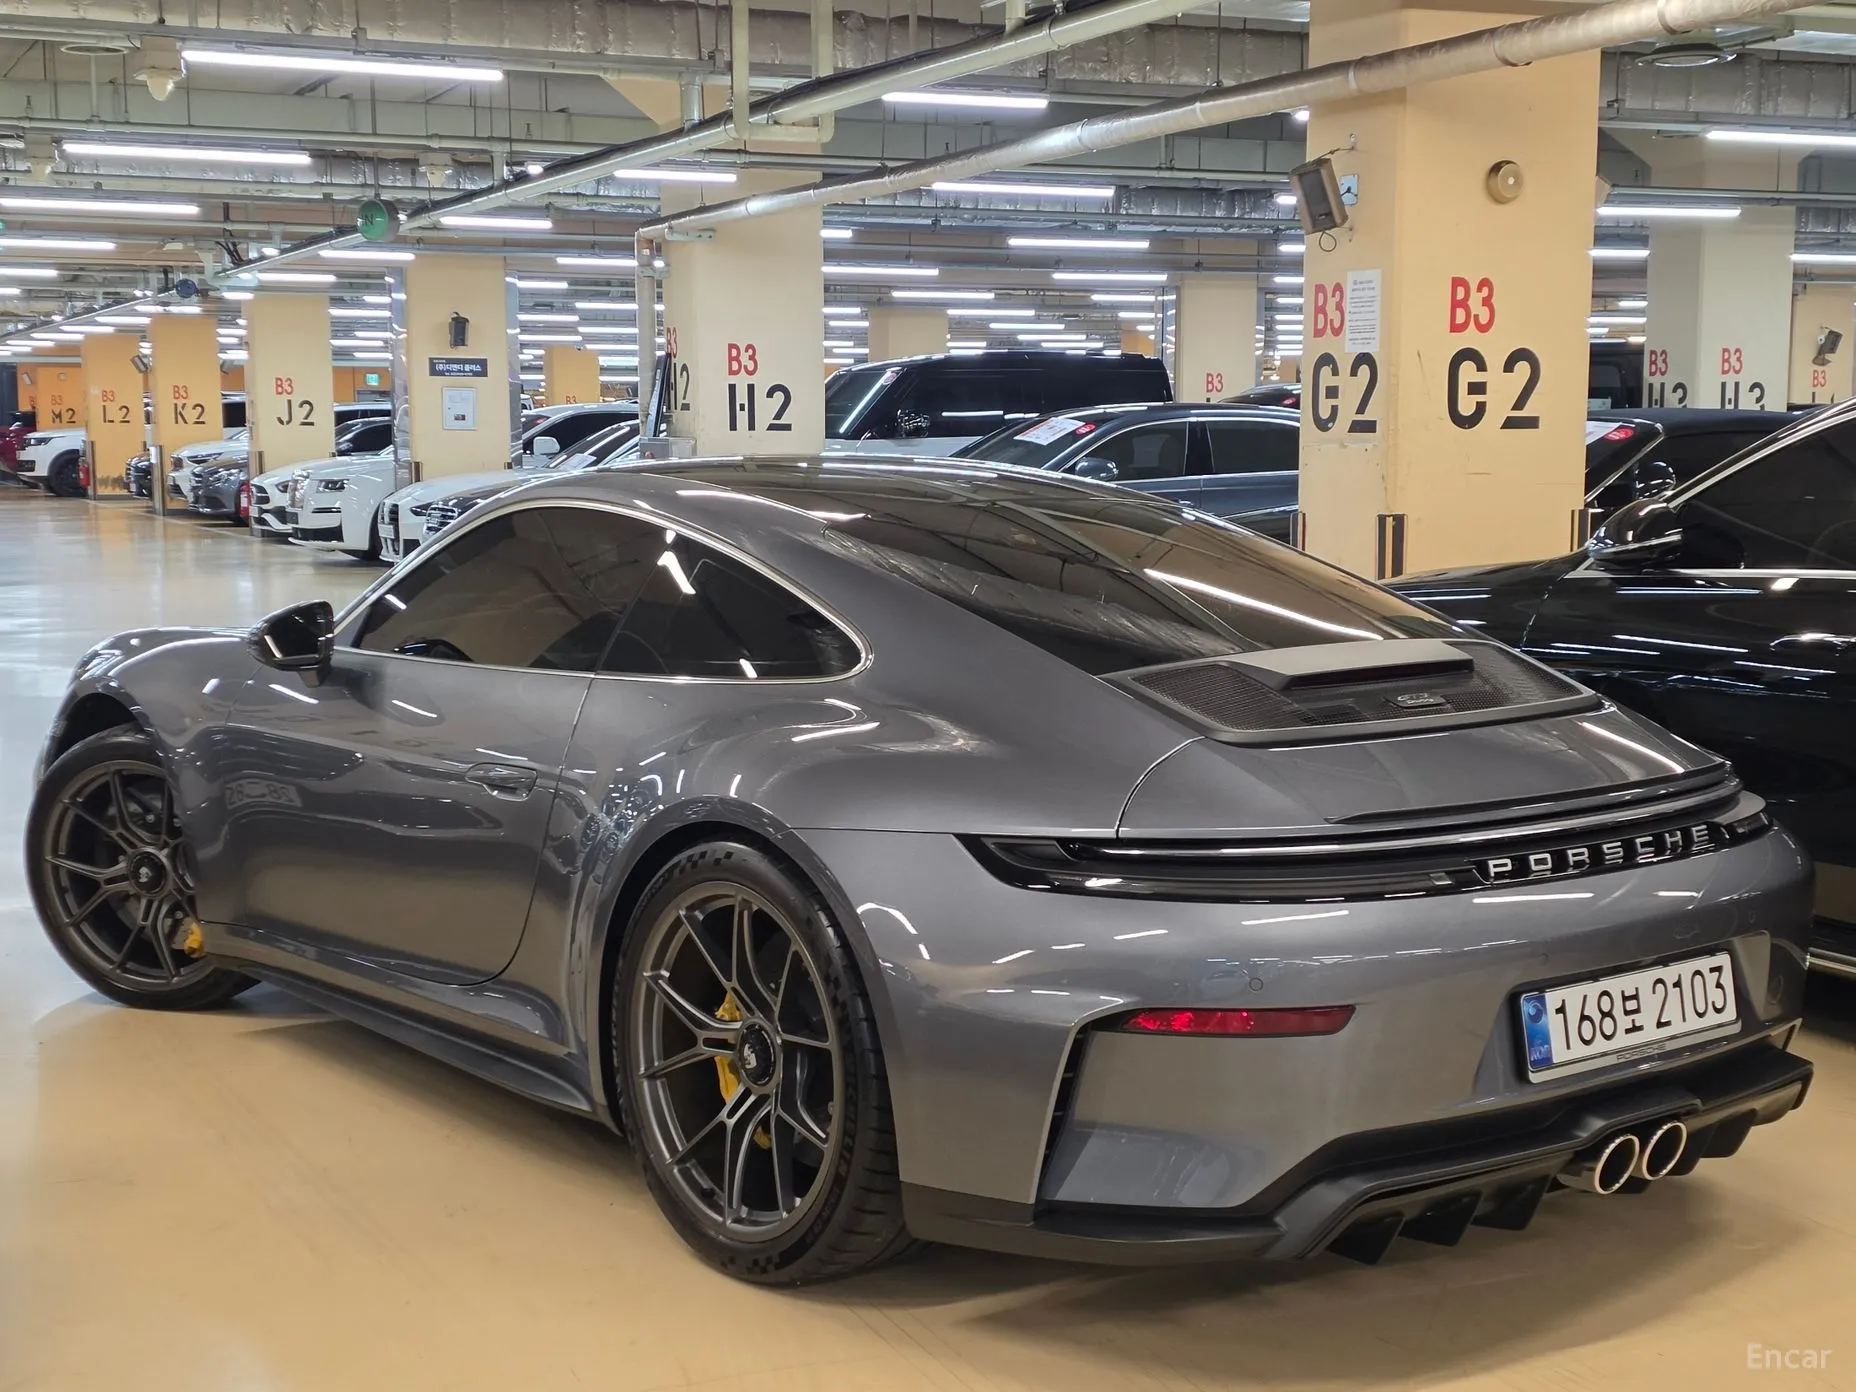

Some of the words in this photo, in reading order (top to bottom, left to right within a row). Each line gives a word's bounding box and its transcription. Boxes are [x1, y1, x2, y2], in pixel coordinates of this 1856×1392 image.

[1313, 282, 1345, 338] B3
[1449, 276, 1496, 334] B3
[666, 326, 678, 359] B3
[727, 342, 759, 377] B3
[1649, 350, 1669, 377] B3
[1721, 348, 1743, 375] B3
[172, 384, 189, 400] B3
[275, 377, 294, 395] B3
[1206, 373, 1224, 393] B3
[1447, 347, 1541, 430] G2
[1812, 369, 1827, 388] B3
[51, 394, 63, 406] B3
[102, 390, 115, 402] B3
[1311, 352, 1379, 433] G2
[51, 408, 77, 424] M2
[102, 405, 131, 424] L2
[174, 402, 206, 425] K2
[276, 399, 315, 426] J2
[727, 383, 793, 432] H2
[1487, 824, 1709, 878] PORSCHE
[1555, 987, 1645, 1051] 168보
[1652, 965, 1728, 1030] 2103
[1616, 1043, 1667, 1061] PORSCHE
